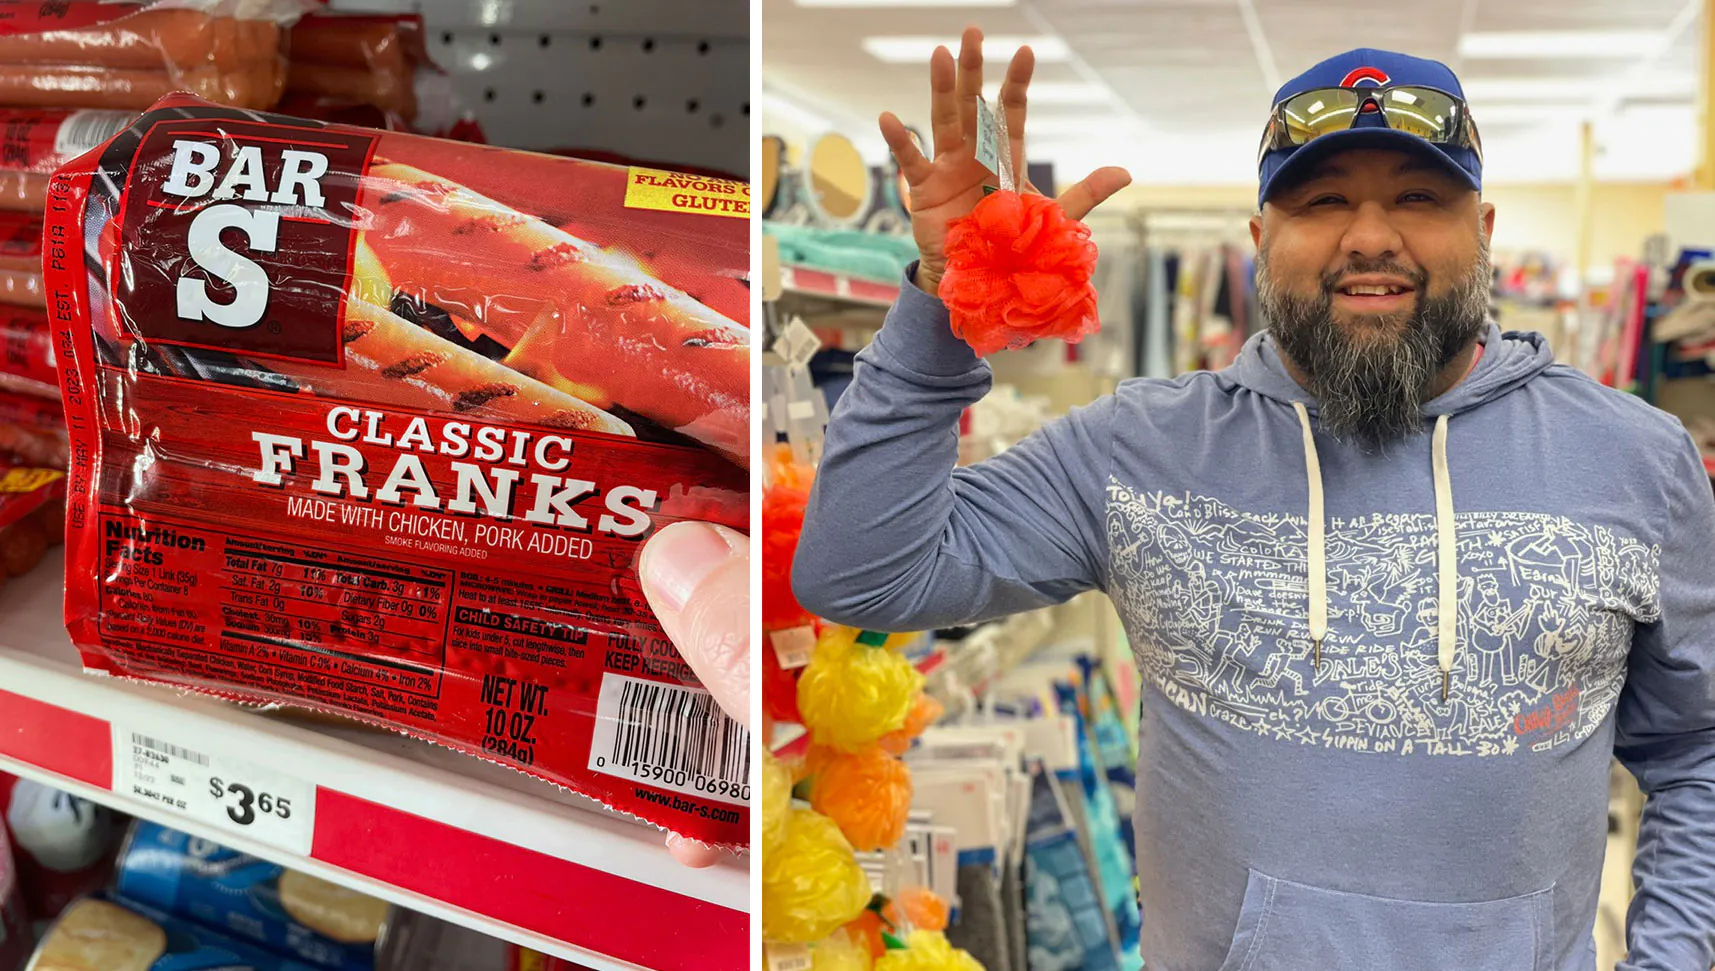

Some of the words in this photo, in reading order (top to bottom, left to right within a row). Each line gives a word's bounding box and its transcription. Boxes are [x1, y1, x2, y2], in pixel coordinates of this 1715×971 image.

[162, 139, 330, 208] BAR
[635, 174, 735, 194] FLAVORS
[671, 193, 750, 213] GLUTE
[176, 203, 280, 328] S
[55, 283, 72, 321] EST.
[66, 367, 82, 405] 2023
[327, 406, 574, 471] CLASSIC
[76, 440, 87, 467] MAY
[251, 431, 659, 538] FRANKS
[105, 520, 205, 552] Nutrition
[287, 496, 336, 524] MADE
[340, 504, 383, 531] WITH
[389, 513, 468, 547] CHICKEN,
[474, 524, 522, 550] PORK
[527, 532, 593, 560] ADDED
[105, 540, 163, 566] Facts
[384, 535, 412, 549] SMOKE
[415, 540, 457, 556] FLAVORING
[460, 547, 488, 560] ADDED
[1193, 548, 1214, 564] WE
[1220, 554, 1282, 571] STARTED
[226, 556, 249, 569] Total
[251, 559, 267, 572] Fat
[271, 562, 283, 577] 7g
[251, 577, 265, 590] Fat
[268, 580, 280, 595] 2g
[301, 585, 323, 600] 10%
[336, 573, 360, 587] Total
[363, 576, 390, 591] Carb.
[392, 581, 404, 596] 3g
[423, 586, 440, 600] 1%
[459, 590, 477, 599] Heat
[231, 590, 253, 604] Trans
[255, 595, 268, 607] Fat
[272, 597, 285, 611] 0g
[343, 592, 374, 609] Dietary
[377, 597, 399, 611] Fiber
[401, 600, 413, 616] 0g
[419, 605, 437, 619] 0%
[298, 619, 320, 632] 10%
[341, 610, 371, 626] Sugars
[373, 615, 385, 630] 2g
[459, 609, 501, 626] CHILD
[504, 616, 556, 637] SAFETY
[562, 624, 584, 641] TIP
[330, 624, 365, 639] Protein
[368, 630, 380, 644] 3g
[483, 632, 502, 644] under
[607, 630, 647, 653] FULLY
[1253, 625, 1283, 636] RUN
[1323, 634, 1365, 645] RUN
[605, 650, 639, 672] KEEP
[1355, 644, 1396, 656] RIDE
[280, 649, 308, 666] Vitamin
[340, 661, 374, 679] Calcium
[399, 673, 415, 688] Iron
[417, 677, 432, 691] 2%
[480, 673, 517, 708] NET
[520, 683, 549, 716] WT.
[484, 707, 505, 738] 10
[509, 713, 537, 745] OZ.
[481, 735, 535, 767] (284g)
[1374, 738, 1396, 754] ON
[1400, 738, 1414, 756] A
[1414, 737, 1473, 757] TALL
[596, 756, 605, 768] 0
[631, 761, 686, 787] 15900
[694, 774, 750, 801] 06980
[635, 786, 741, 825] www.bar-s.com
